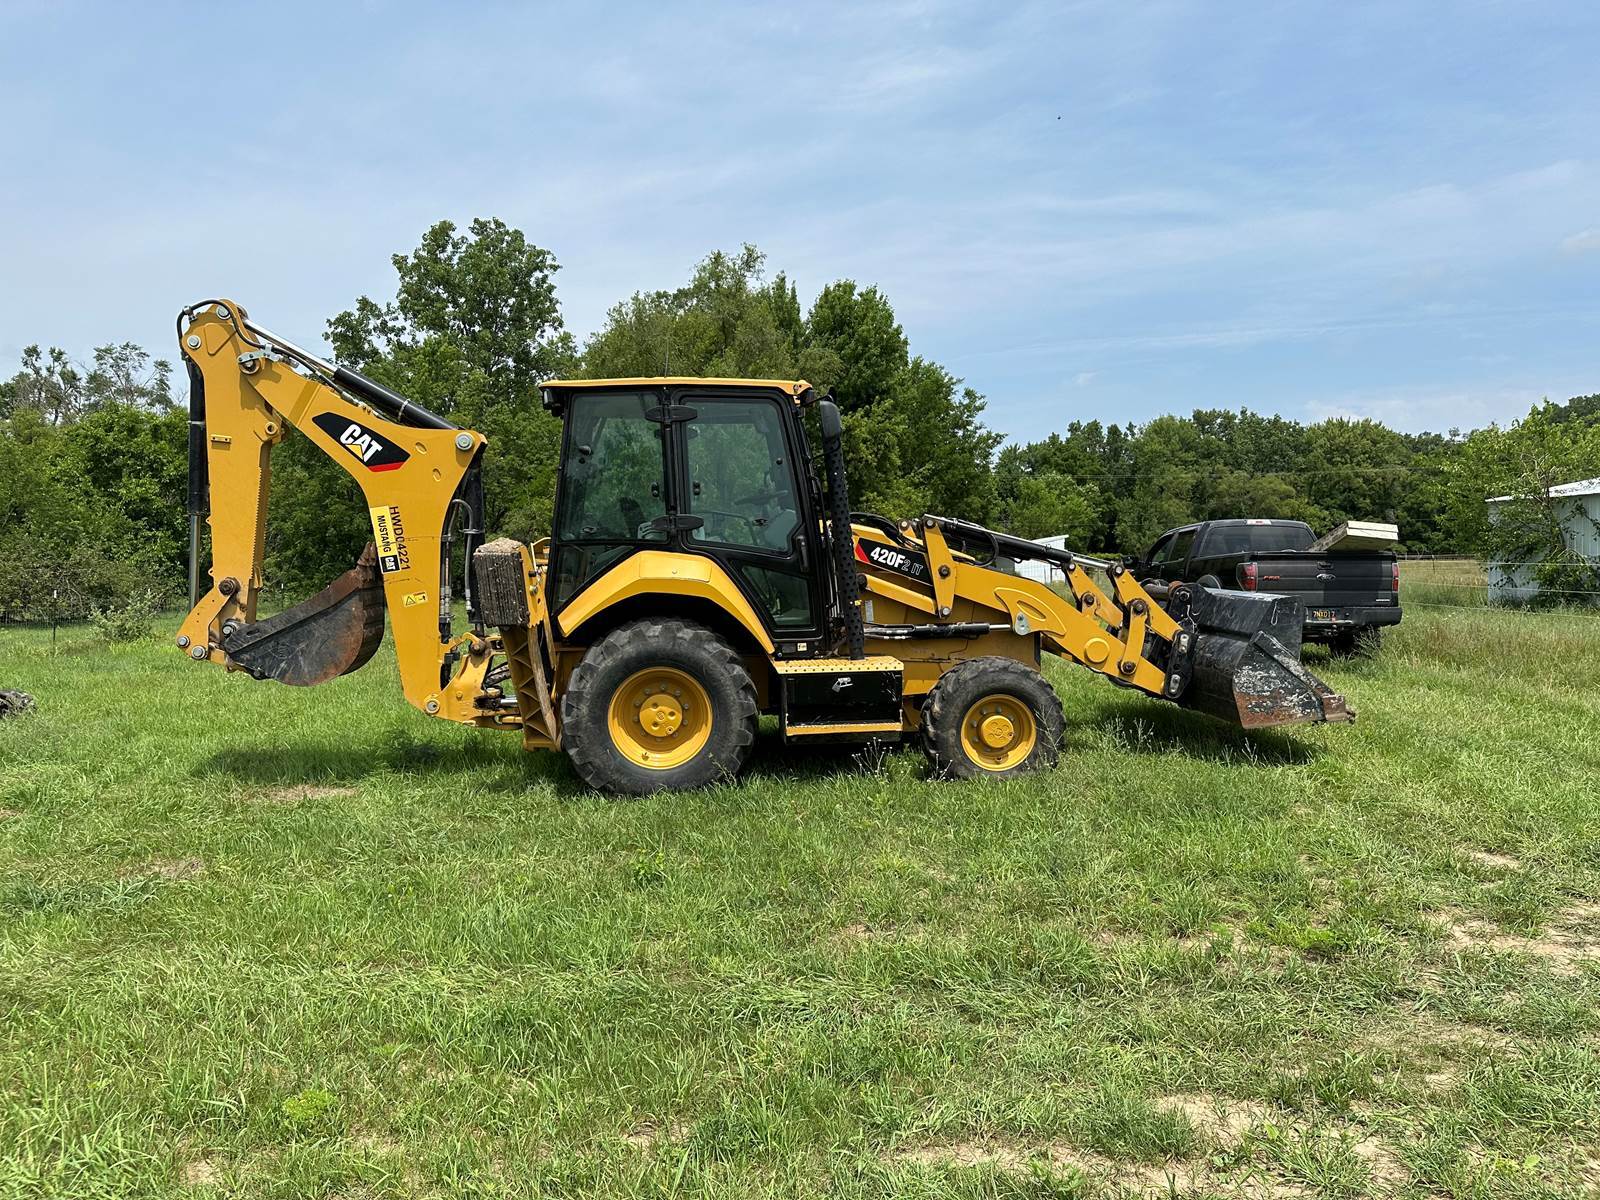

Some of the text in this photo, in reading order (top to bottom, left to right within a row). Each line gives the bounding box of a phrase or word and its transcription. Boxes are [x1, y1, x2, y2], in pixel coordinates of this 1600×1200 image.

[339, 423, 383, 462] CAT
[377, 515, 390, 553] MUSTANG
[389, 506, 411, 570] HWD04221
[384, 556, 396, 570] CAT
